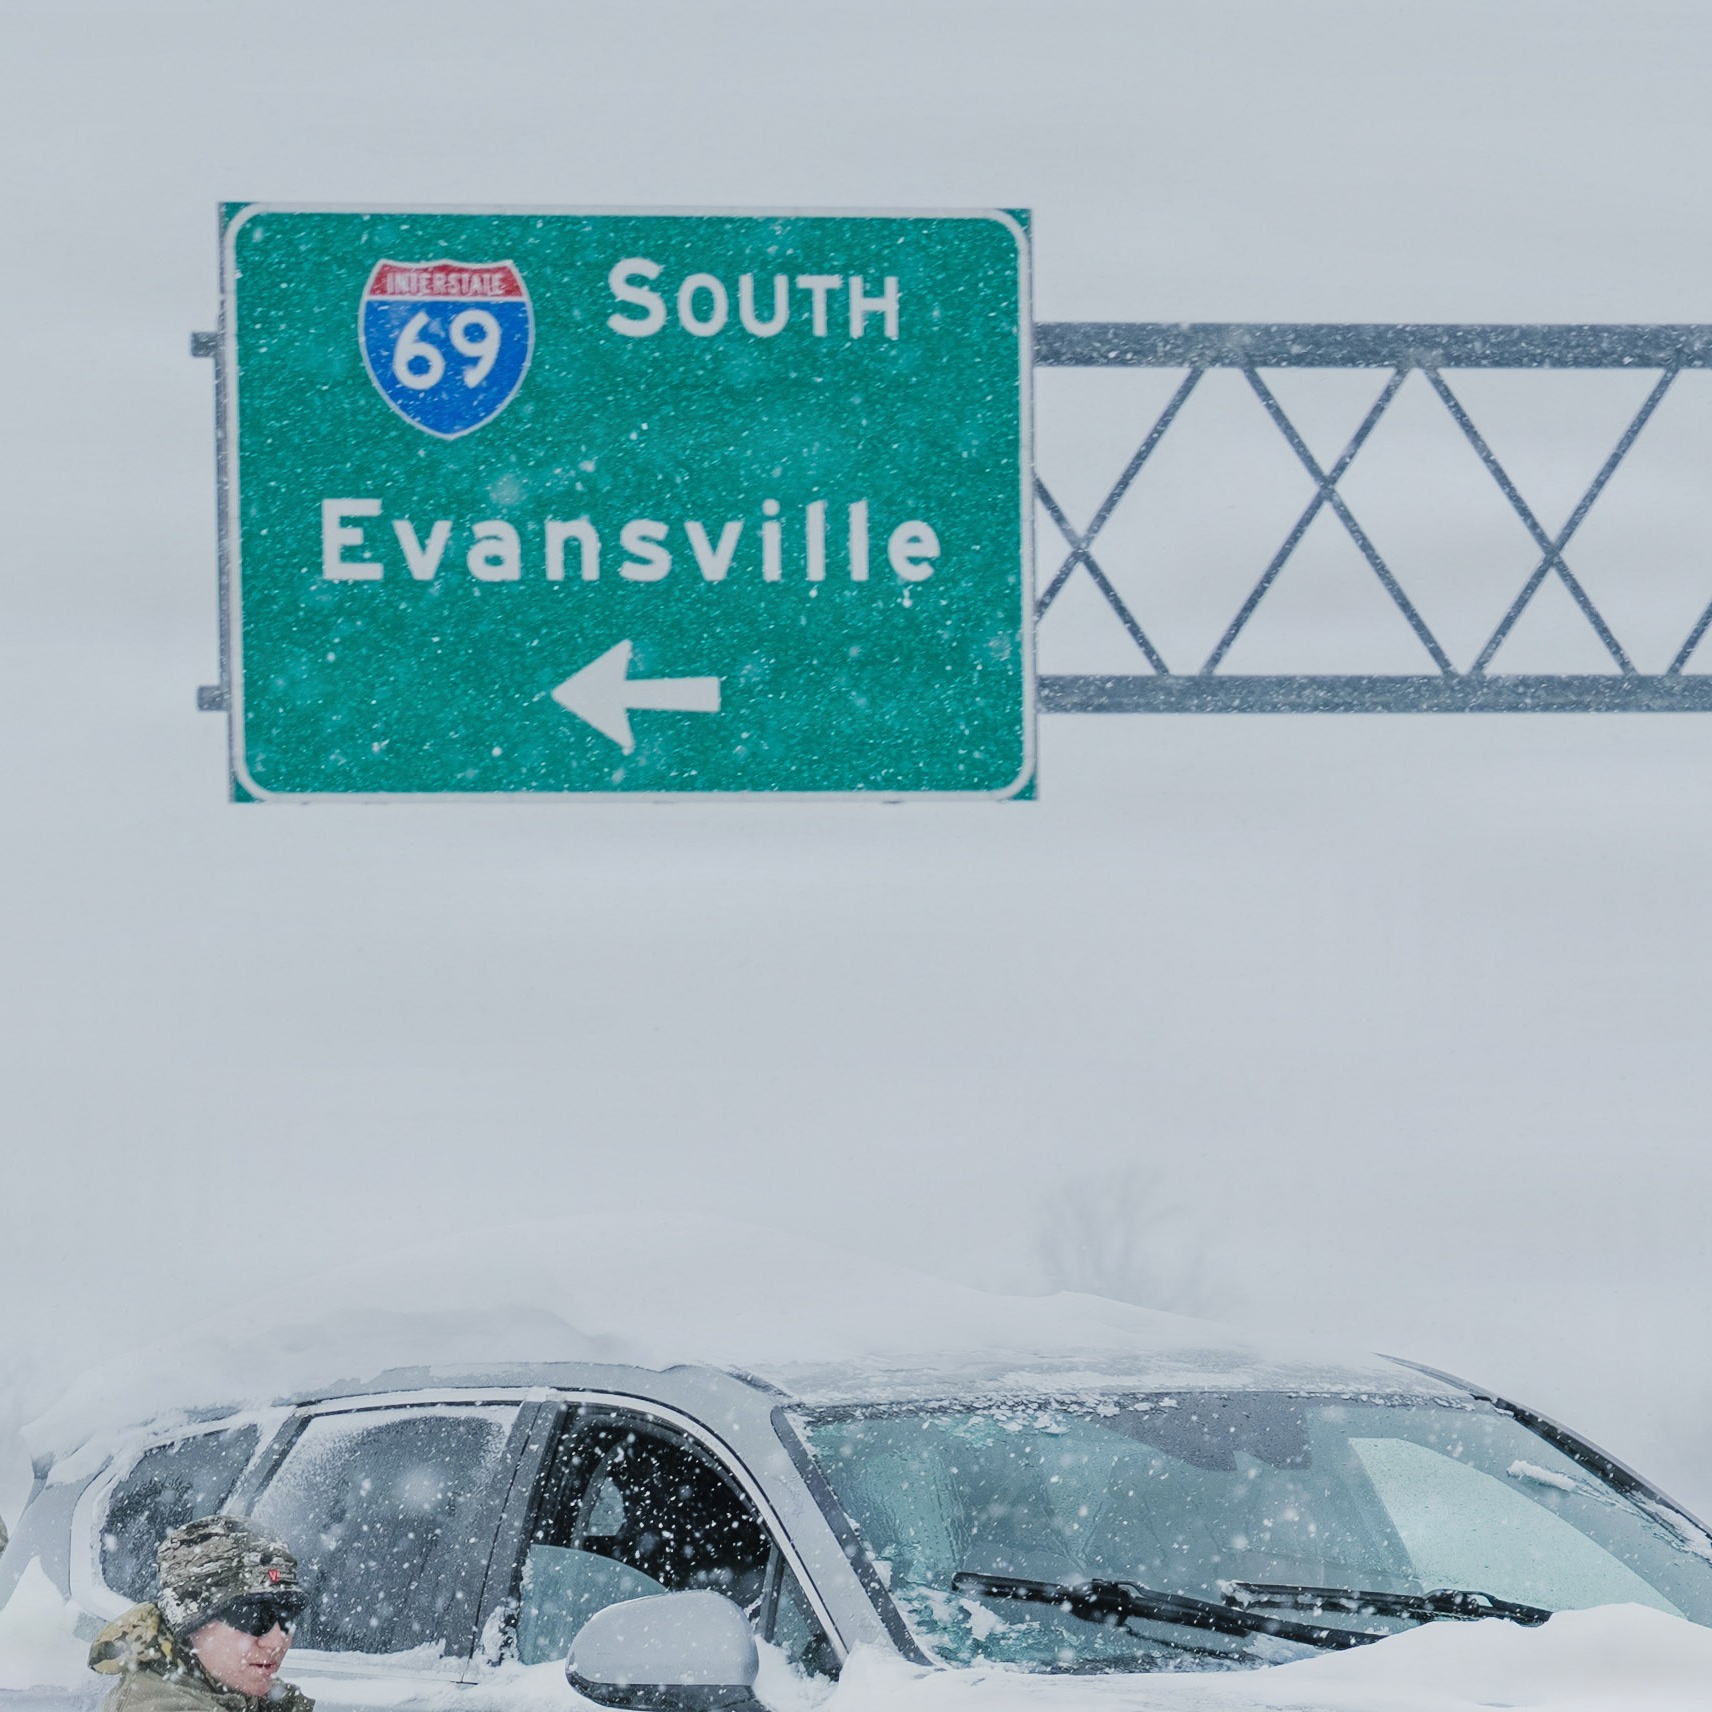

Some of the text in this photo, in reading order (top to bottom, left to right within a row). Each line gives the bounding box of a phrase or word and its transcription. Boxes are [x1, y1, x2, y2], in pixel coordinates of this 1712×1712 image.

[386, 272, 506, 295] INTERSTATE
[607, 257, 900, 341] SOUTH
[393, 309, 501, 390] 69
[321, 498, 942, 582] Evansville
